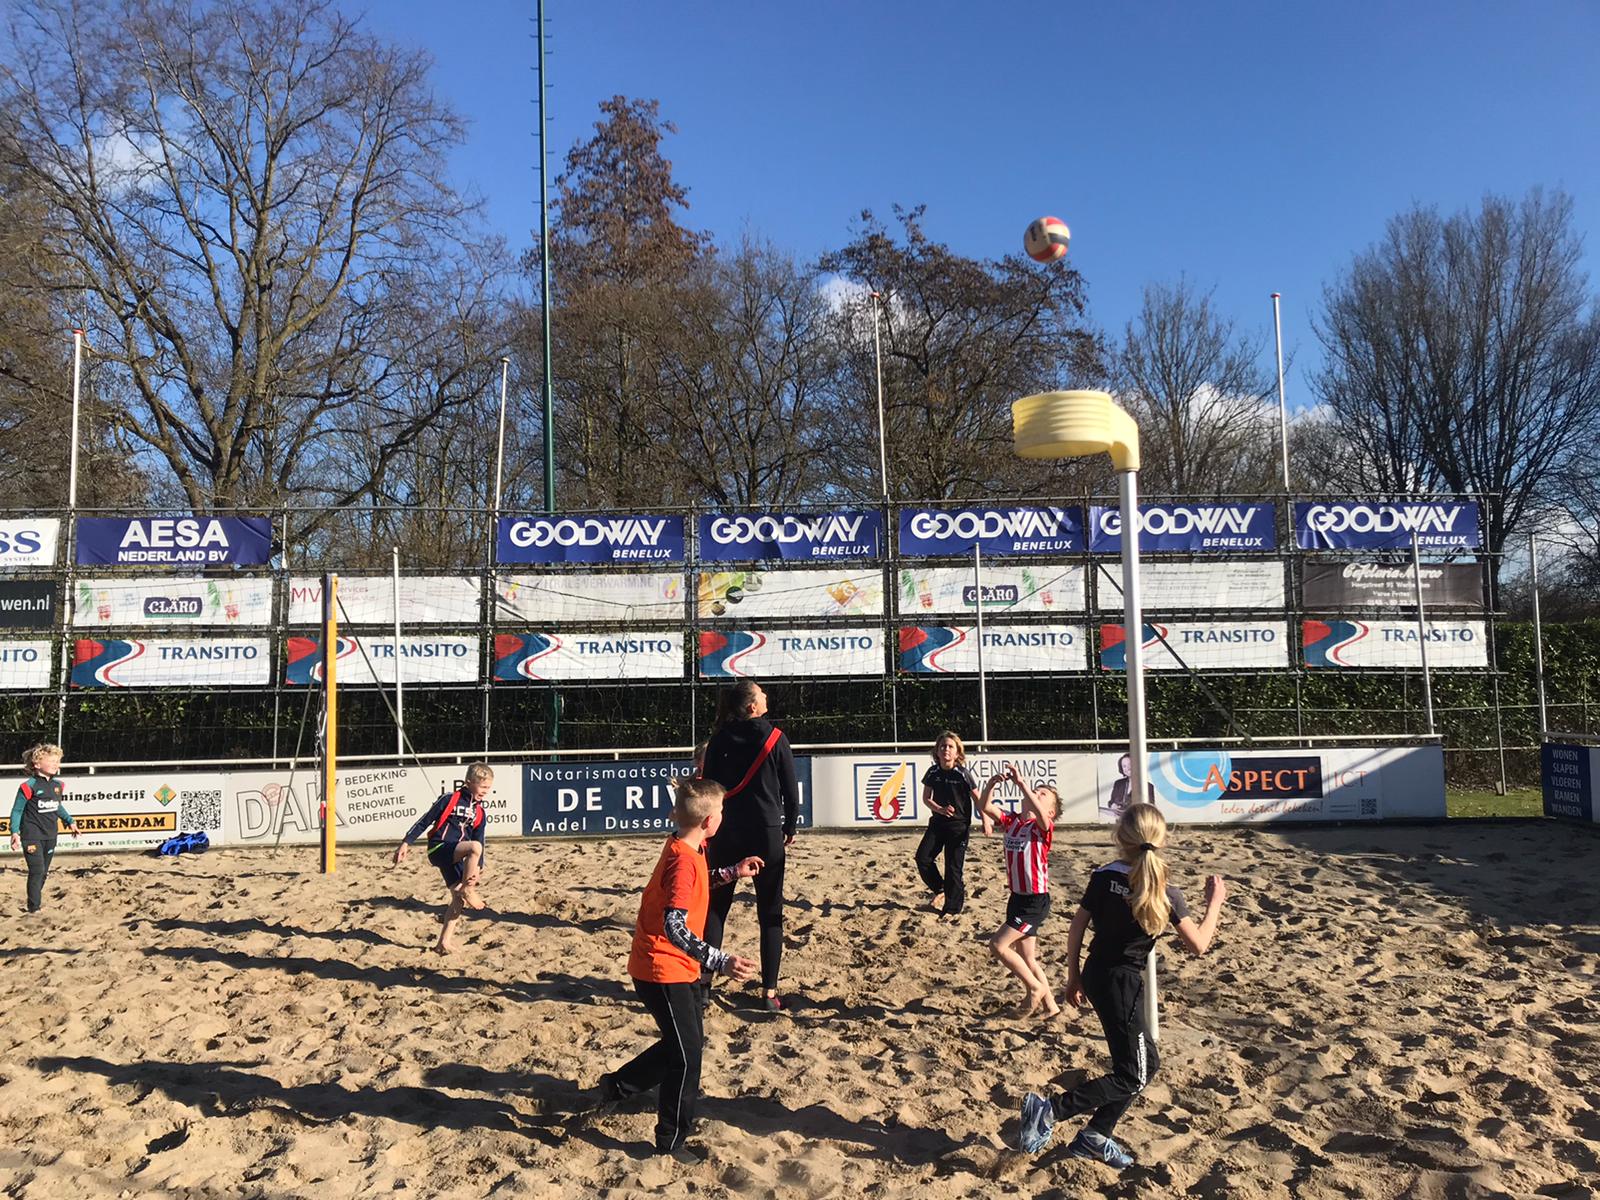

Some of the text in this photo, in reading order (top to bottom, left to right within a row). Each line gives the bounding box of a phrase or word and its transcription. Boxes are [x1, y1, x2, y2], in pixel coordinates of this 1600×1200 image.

[911, 511, 1065, 540] GOODWAY
[1100, 507, 1256, 536] GODWAY
[1306, 506, 1460, 533] GOODWAY
[119, 519, 229, 548] AESA
[509, 519, 667, 548] GOODWAY
[710, 515, 864, 544] GOODWAY
[1013, 540, 1073, 551] BENELUX
[1202, 537, 1263, 547] BENELUX
[118, 550, 228, 562] NEDERLAND BV
[612, 549, 672, 558] BENELUX
[811, 545, 870, 556] BENELUX
[777, 636, 873, 651] TRANSITO
[981, 632, 1073, 647] TRANSITO
[1180, 629, 1276, 643] TRANSITO
[158, 645, 257, 660] TRANSITO
[370, 643, 467, 658] TRANSITO
[576, 639, 672, 654] TRANSITO
[0, 648, 38, 662] ITO
[344, 769, 408, 786] BEDEKKING
[346, 784, 394, 799] ISOLATIE
[557, 786, 603, 812] DE
[348, 795, 406, 812] RENOVATIE
[482, 799, 507, 809] DAM
[349, 807, 417, 825] ONDERHOUD
[486, 813, 518, 823] 05110
[531, 816, 587, 833] Andel
